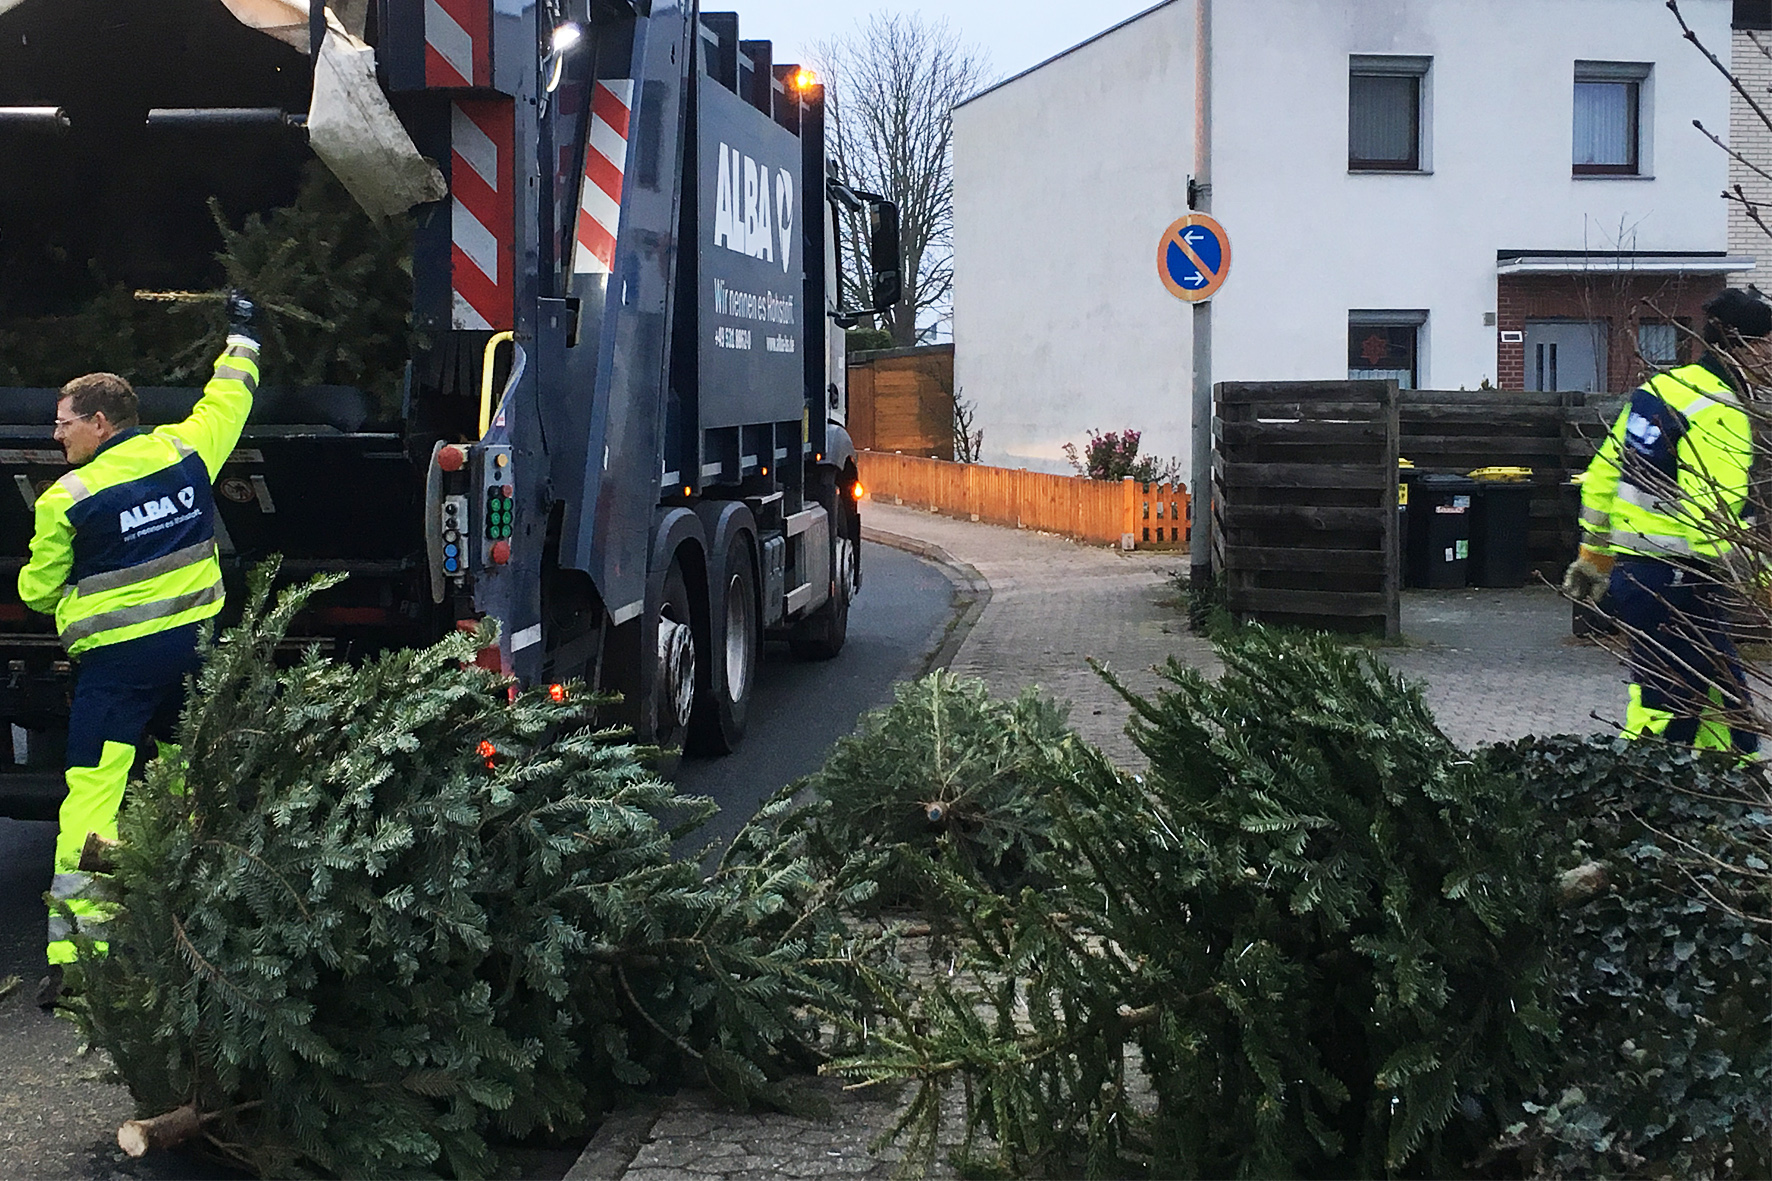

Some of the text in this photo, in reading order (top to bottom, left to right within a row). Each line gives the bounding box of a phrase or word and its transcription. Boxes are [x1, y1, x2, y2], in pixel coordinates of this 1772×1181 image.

[714, 142, 774, 263] ALBA
[714, 278, 729, 315] Wir
[729, 290, 758, 320] nennen
[758, 296, 767, 322] es
[120, 496, 179, 534] ALBA
